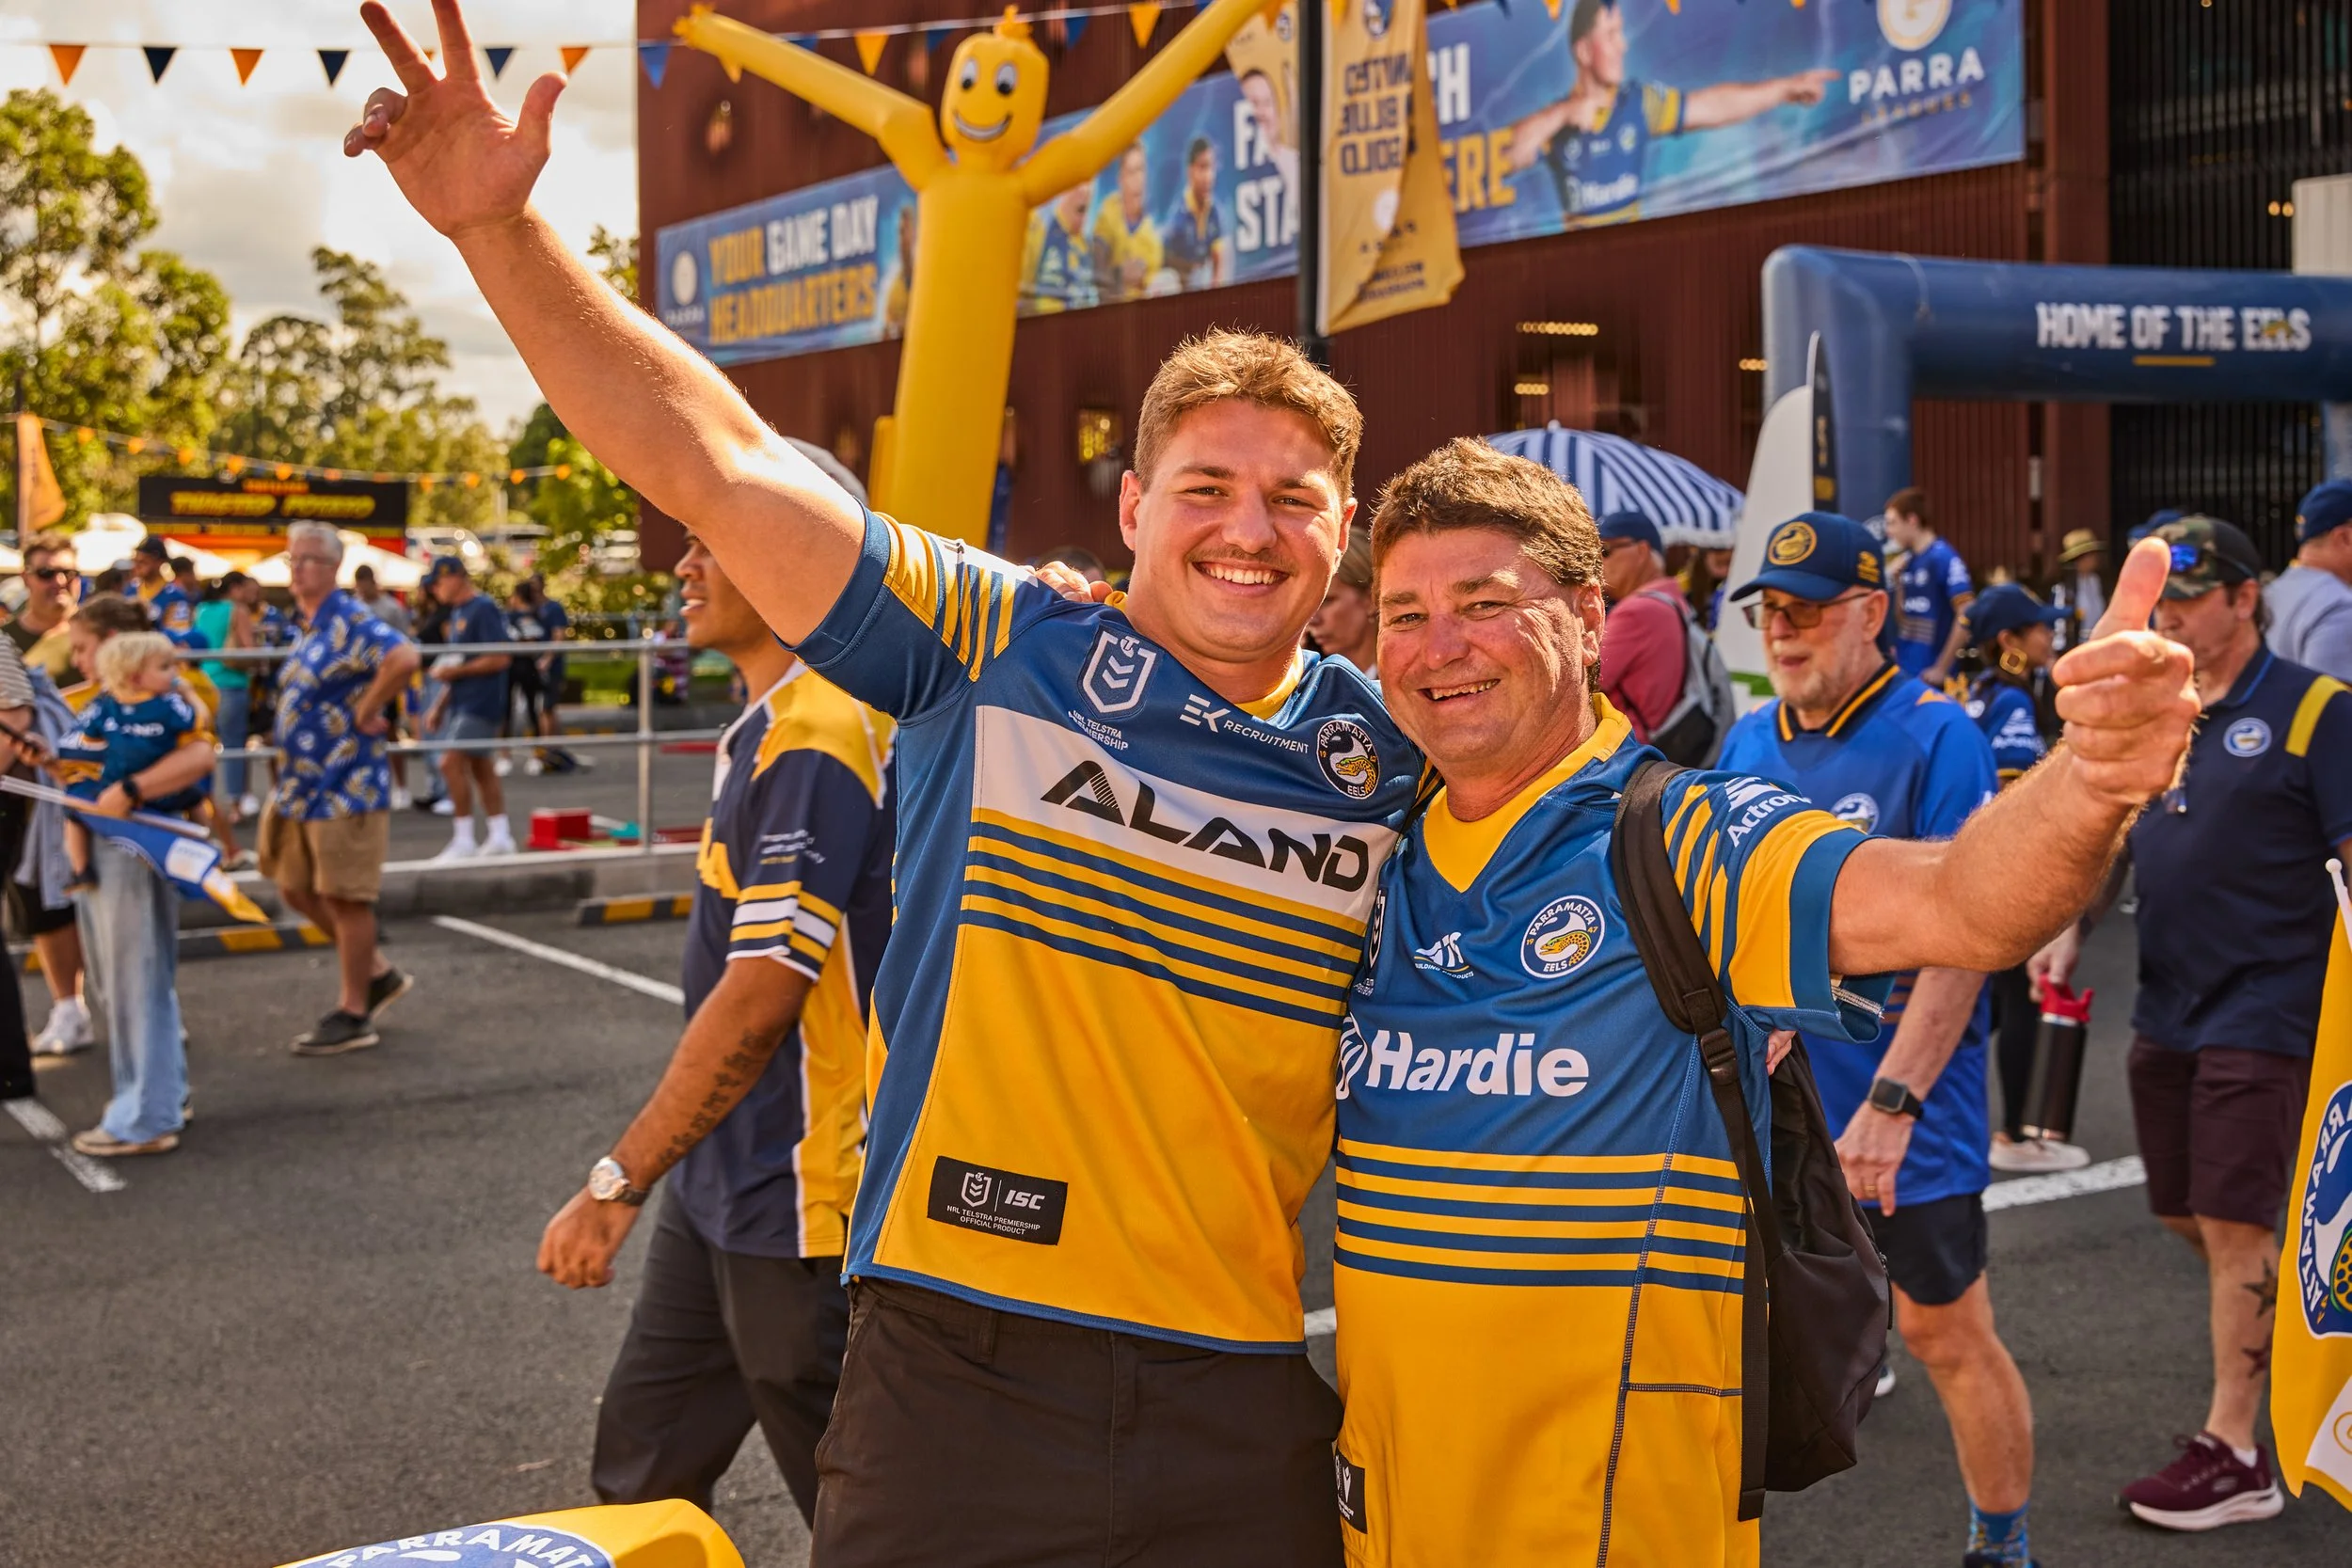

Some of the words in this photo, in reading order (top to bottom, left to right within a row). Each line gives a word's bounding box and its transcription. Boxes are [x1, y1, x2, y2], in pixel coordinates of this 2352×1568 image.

[1849, 46, 1985, 104] PARRA
[707, 225, 766, 288] YOUR
[767, 207, 830, 276] GAME
[830, 194, 879, 261] DAY
[708, 262, 878, 346] HEADQUARTERS
[2036, 301, 2126, 349] HOME
[2130, 304, 2171, 349] OF
[2174, 306, 2235, 350] THE
[2239, 307, 2312, 351] EELS
[1087, 719, 1122, 739] TELSTRA
[1224, 720, 1309, 753] RECRUITMENT
[1320, 722, 1374, 749] PARRAMATTA
[1347, 784, 1366, 797] EELS
[1040, 760, 1369, 893] ALAND
[1529, 902, 1597, 936] PARRAMATTA
[1526, 938, 1534, 946] 19
[1587, 926, 1598, 934] 47
[1543, 960, 1568, 973] EELS
[1365, 1030, 1589, 1097] Hardie
[1005, 1189, 1045, 1211] ISC
[946, 1205, 961, 1214] NRL
[961, 1209, 993, 1222] TELSTRA
[993, 1216, 1041, 1231] PREMIERSHIP
[960, 1215, 992, 1228] OFFICIAL
[993, 1223, 1026, 1235] PRODUCT
